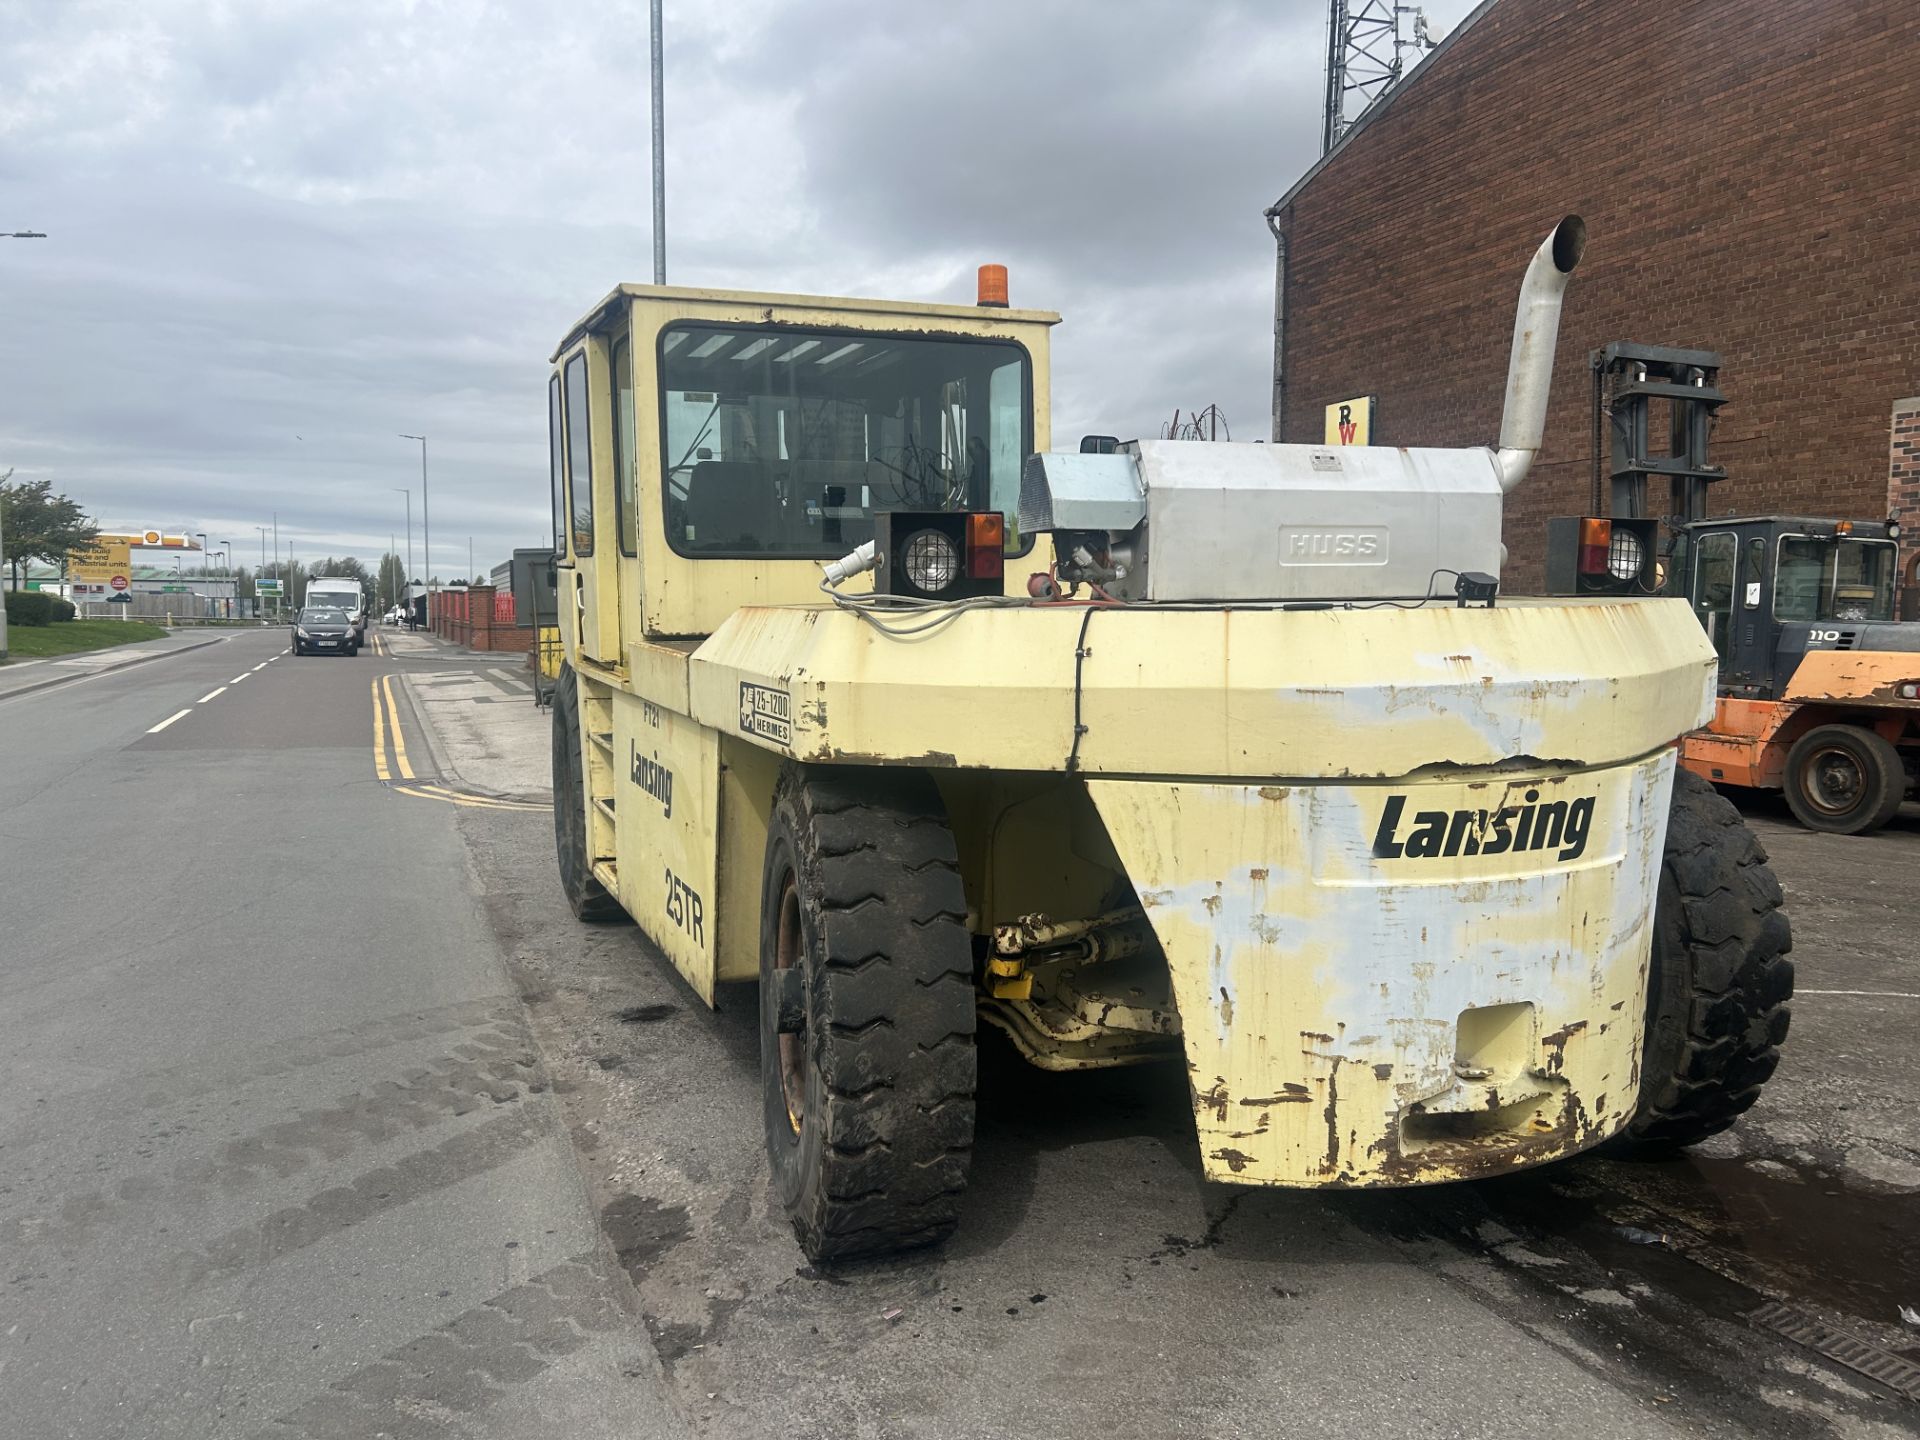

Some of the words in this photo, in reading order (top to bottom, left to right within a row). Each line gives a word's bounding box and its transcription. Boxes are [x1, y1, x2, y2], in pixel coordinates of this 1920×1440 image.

[1339, 405, 1351, 425] R
[1339, 423, 1357, 446] W
[1290, 534, 1377, 556] HUSS
[109, 560, 128, 568] units
[1809, 630, 1840, 641] 110
[756, 690, 788, 717] 25-1200
[643, 702, 660, 730] FT21
[756, 718, 788, 740] HERMES
[630, 738, 673, 819] Lansing
[1371, 789, 1597, 862] Lansing
[665, 867, 705, 949] 25TR
